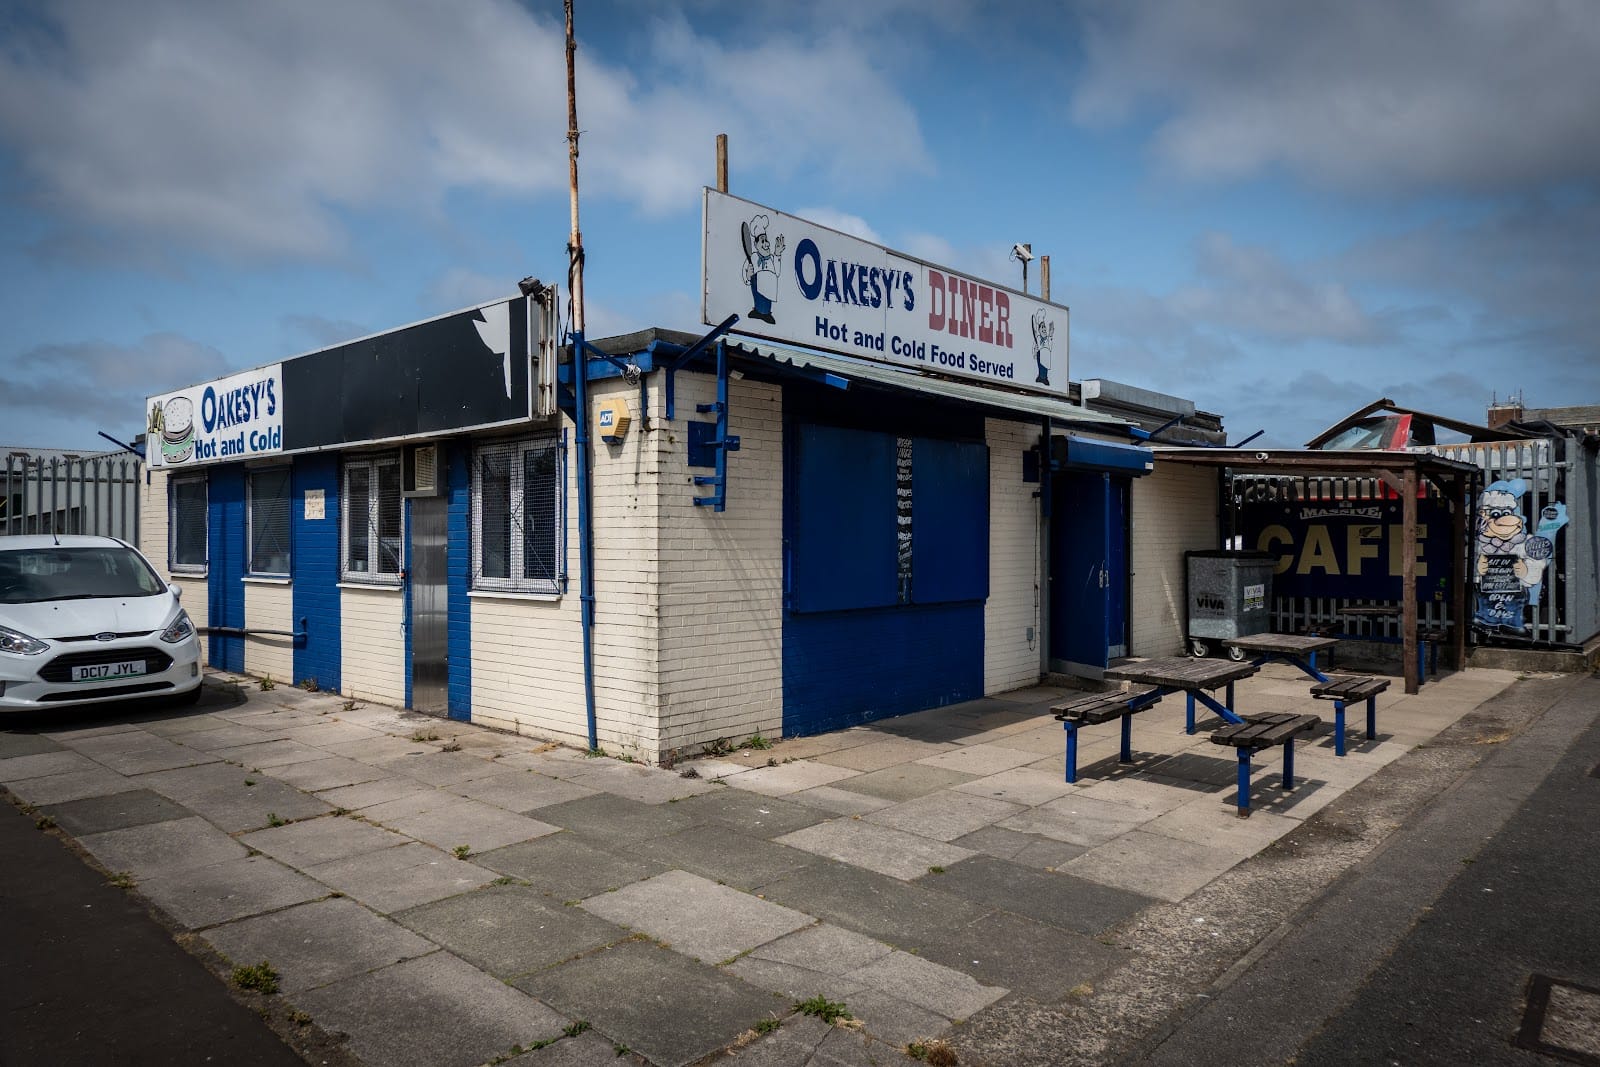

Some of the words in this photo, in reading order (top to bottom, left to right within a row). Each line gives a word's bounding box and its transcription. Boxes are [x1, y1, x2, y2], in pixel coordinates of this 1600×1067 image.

[795, 239, 915, 311] OAKESY'S
[928, 269, 1013, 348] DINER
[815, 316, 848, 343] Hot
[854, 330, 884, 351] and
[891, 336, 925, 360] Cold
[931, 345, 965, 368] Food
[969, 354, 1014, 379] Served
[202, 378, 276, 434] OAKESY'S
[195, 438, 217, 459] Hot
[221, 431, 244, 456] and
[250, 425, 281, 452] Cold
[1257, 524, 1428, 577] CAFE
[80, 665, 109, 678] DC17
[114, 663, 138, 675] JYL
